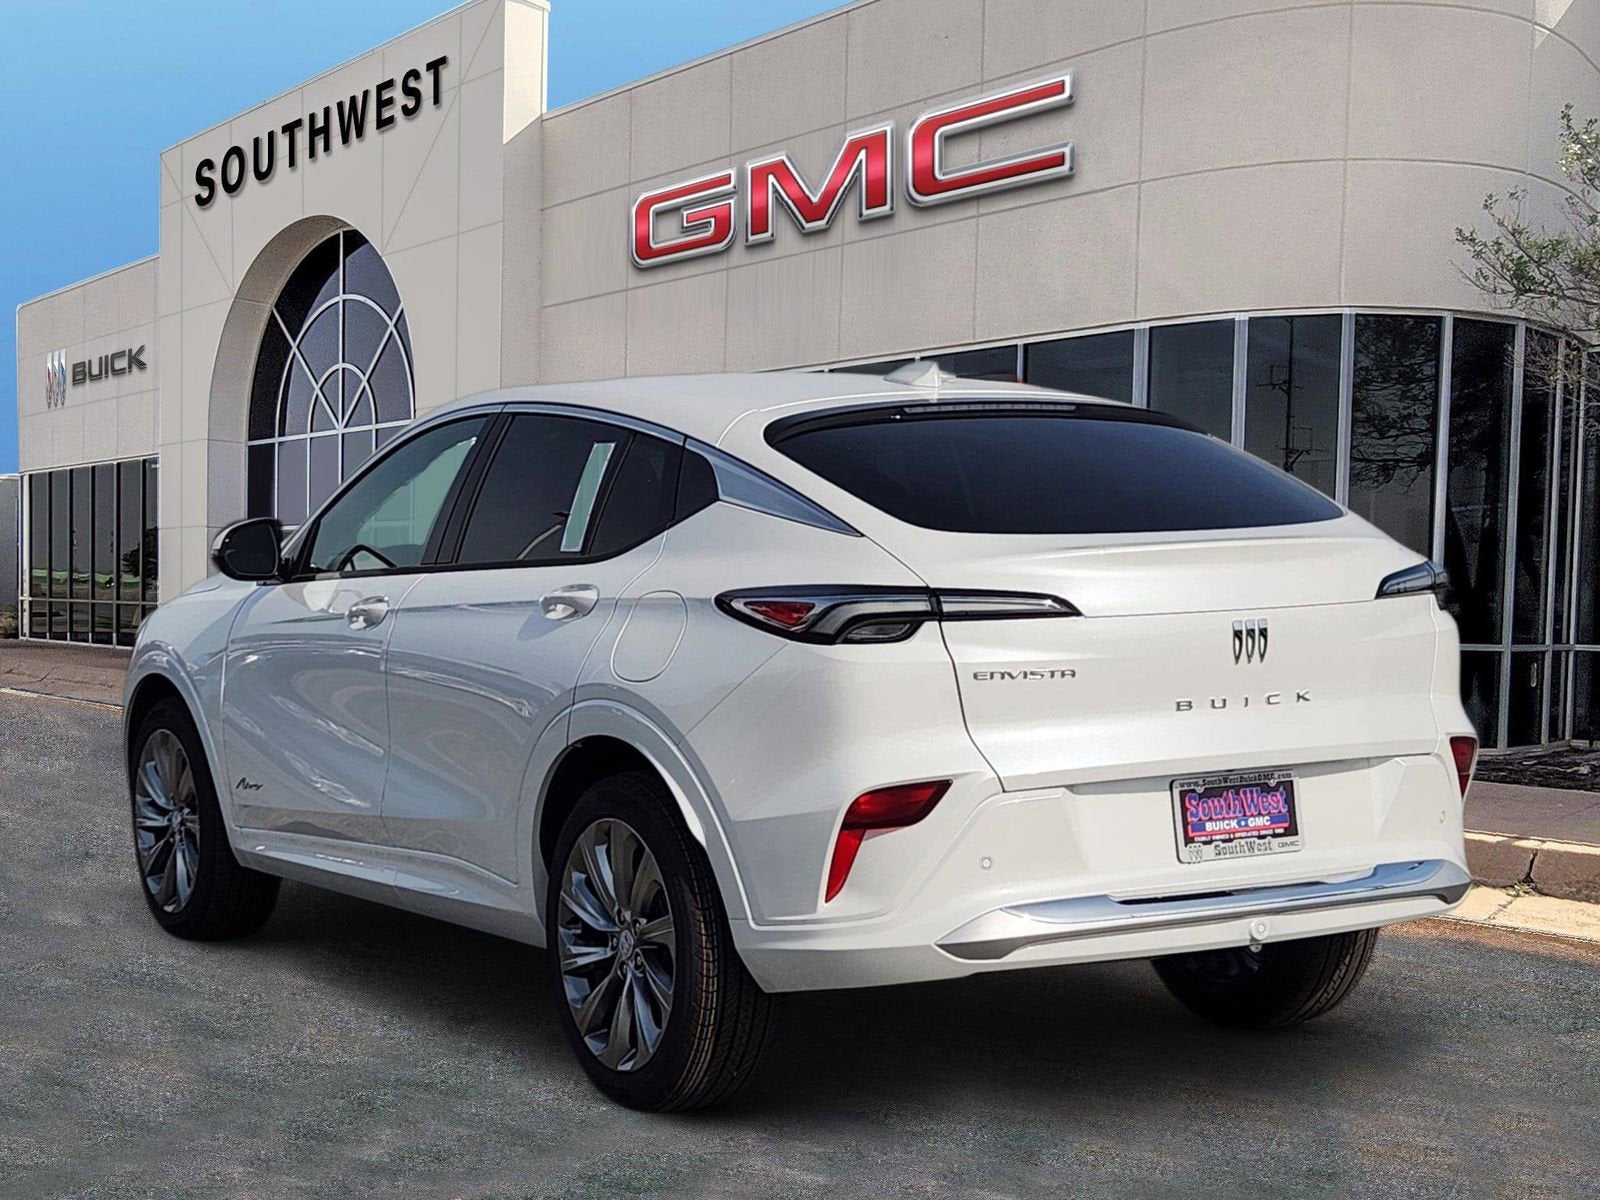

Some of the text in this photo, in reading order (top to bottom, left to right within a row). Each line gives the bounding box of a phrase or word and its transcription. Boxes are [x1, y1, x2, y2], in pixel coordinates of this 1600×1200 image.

[194, 55, 449, 207] SOUTHWEST
[630, 69, 1075, 268] GMC
[72, 344, 147, 386] BUICK
[972, 667, 1077, 681] ENVISTA
[1175, 690, 1311, 712] BUICK
[1185, 786, 1289, 822] SouthWest
[1205, 815, 1271, 832] BUICK GMC
[1214, 839, 1300, 857] SouthWest GMC
